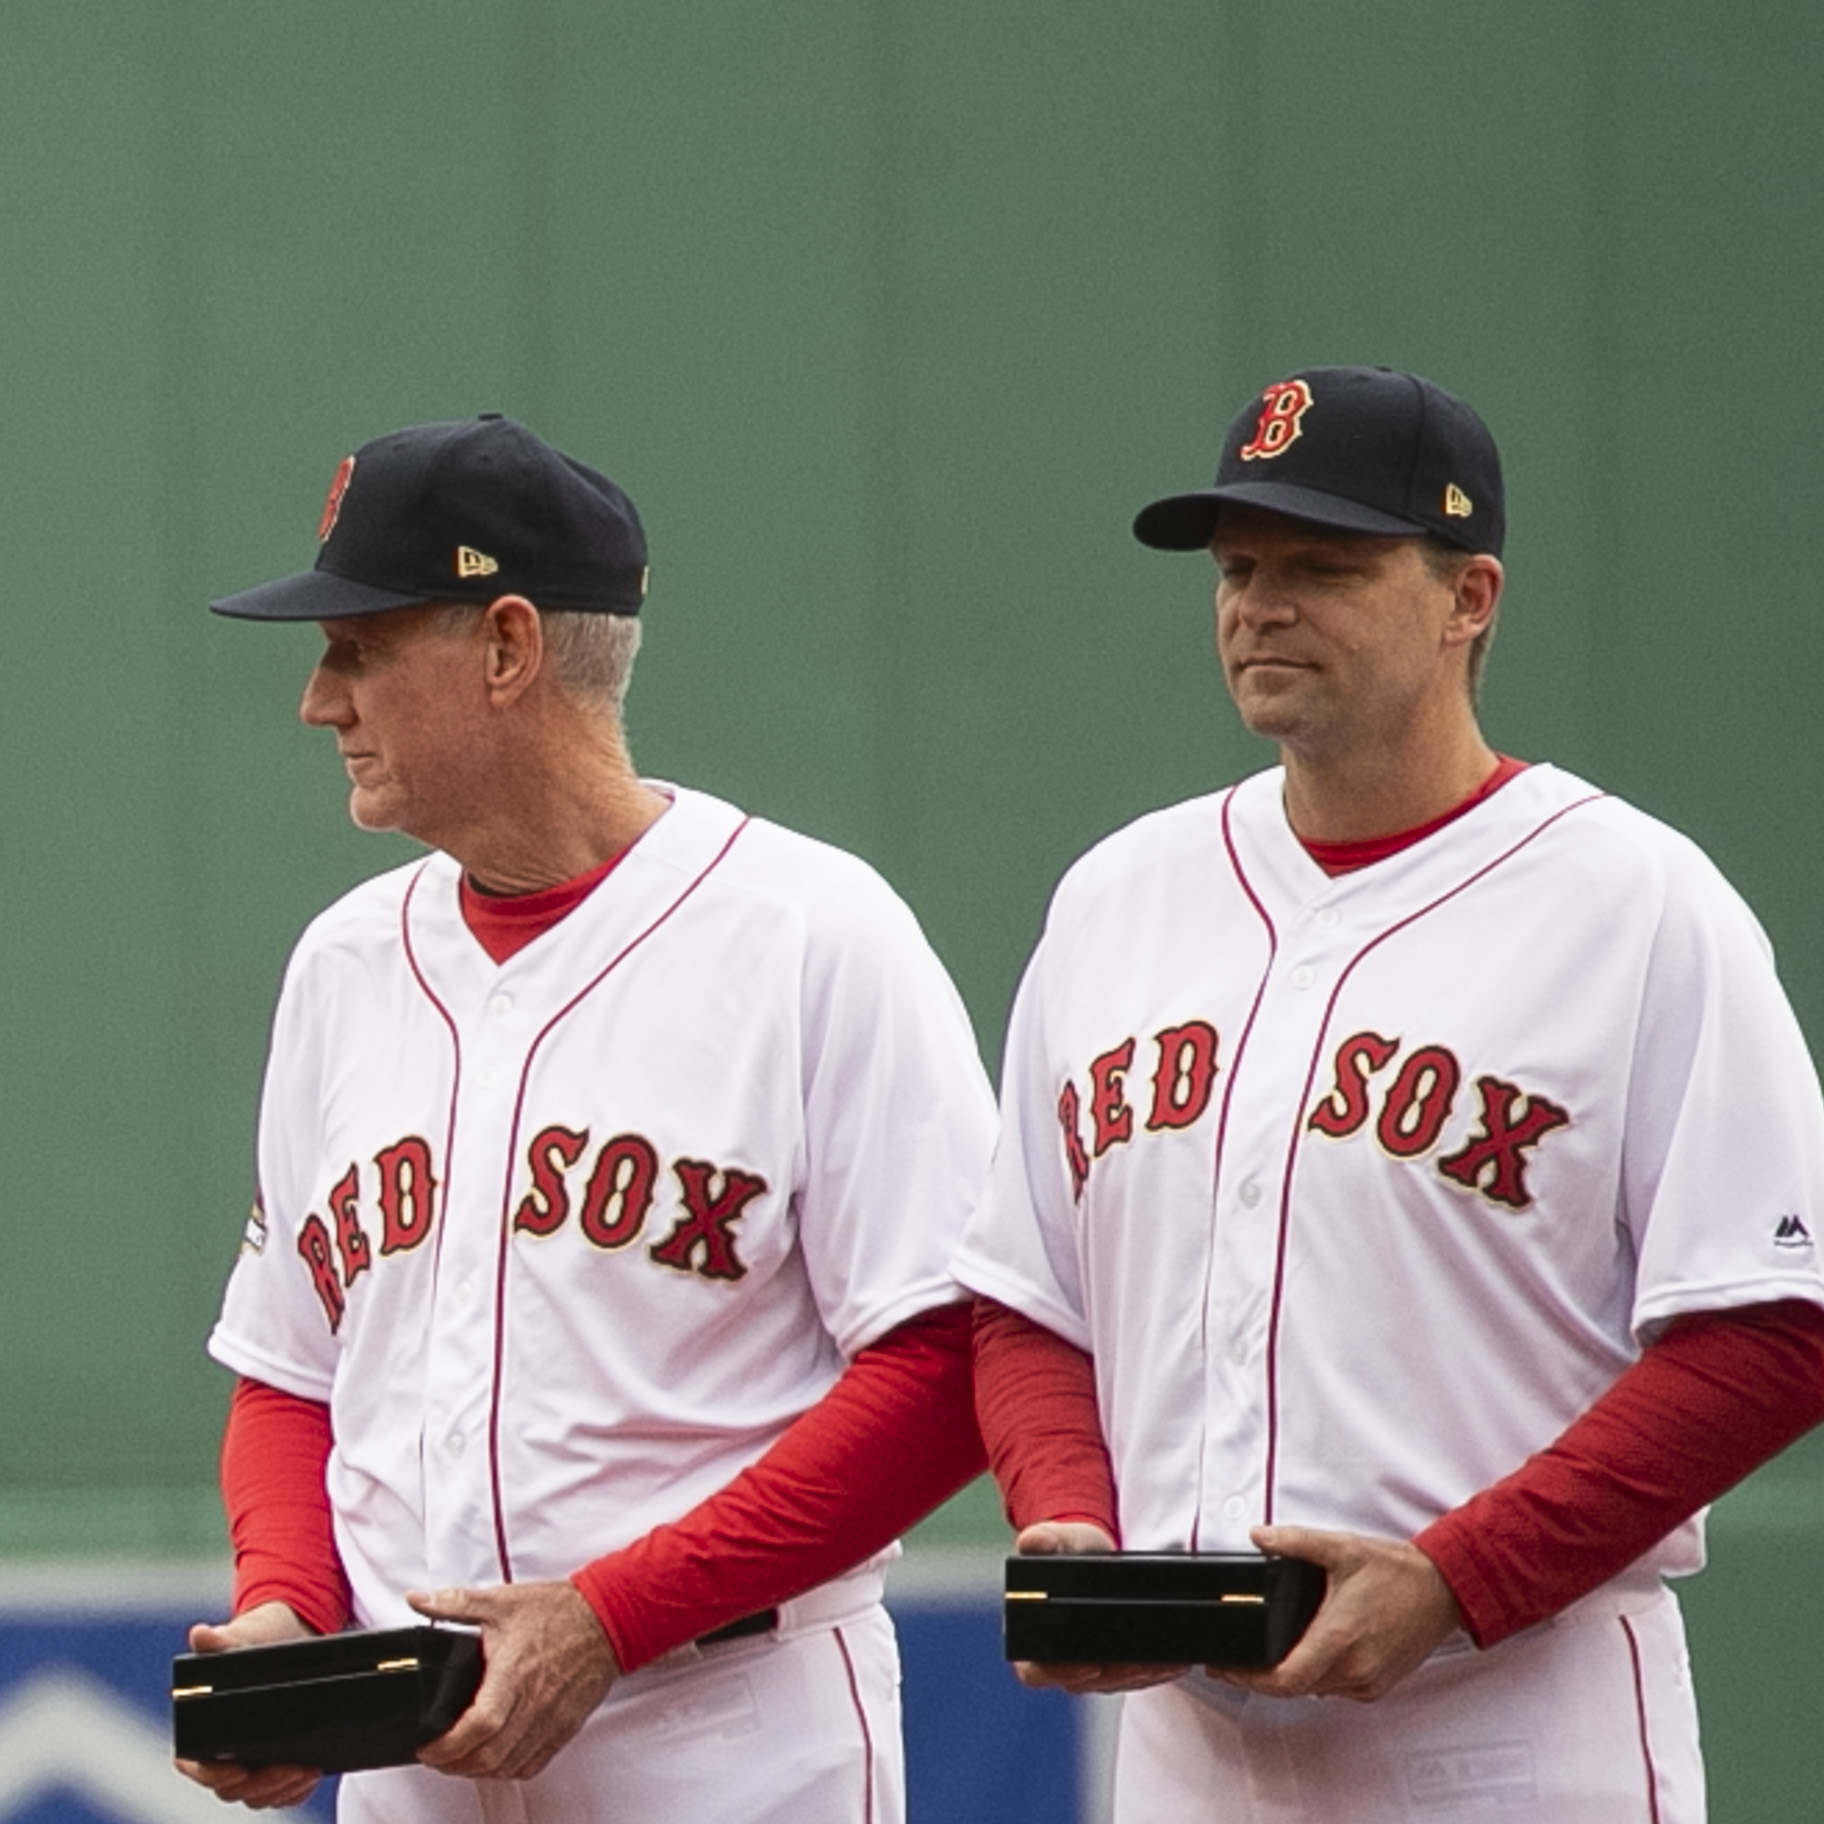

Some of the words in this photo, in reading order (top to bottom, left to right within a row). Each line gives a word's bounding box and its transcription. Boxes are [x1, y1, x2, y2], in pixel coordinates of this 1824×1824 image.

[1241, 380, 1314, 461] B
[1056, 1018, 1220, 1206] RED
[1305, 1029, 1571, 1213] SOX
[297, 1135, 438, 1336] RED
[513, 1125, 768, 1281] SOX
